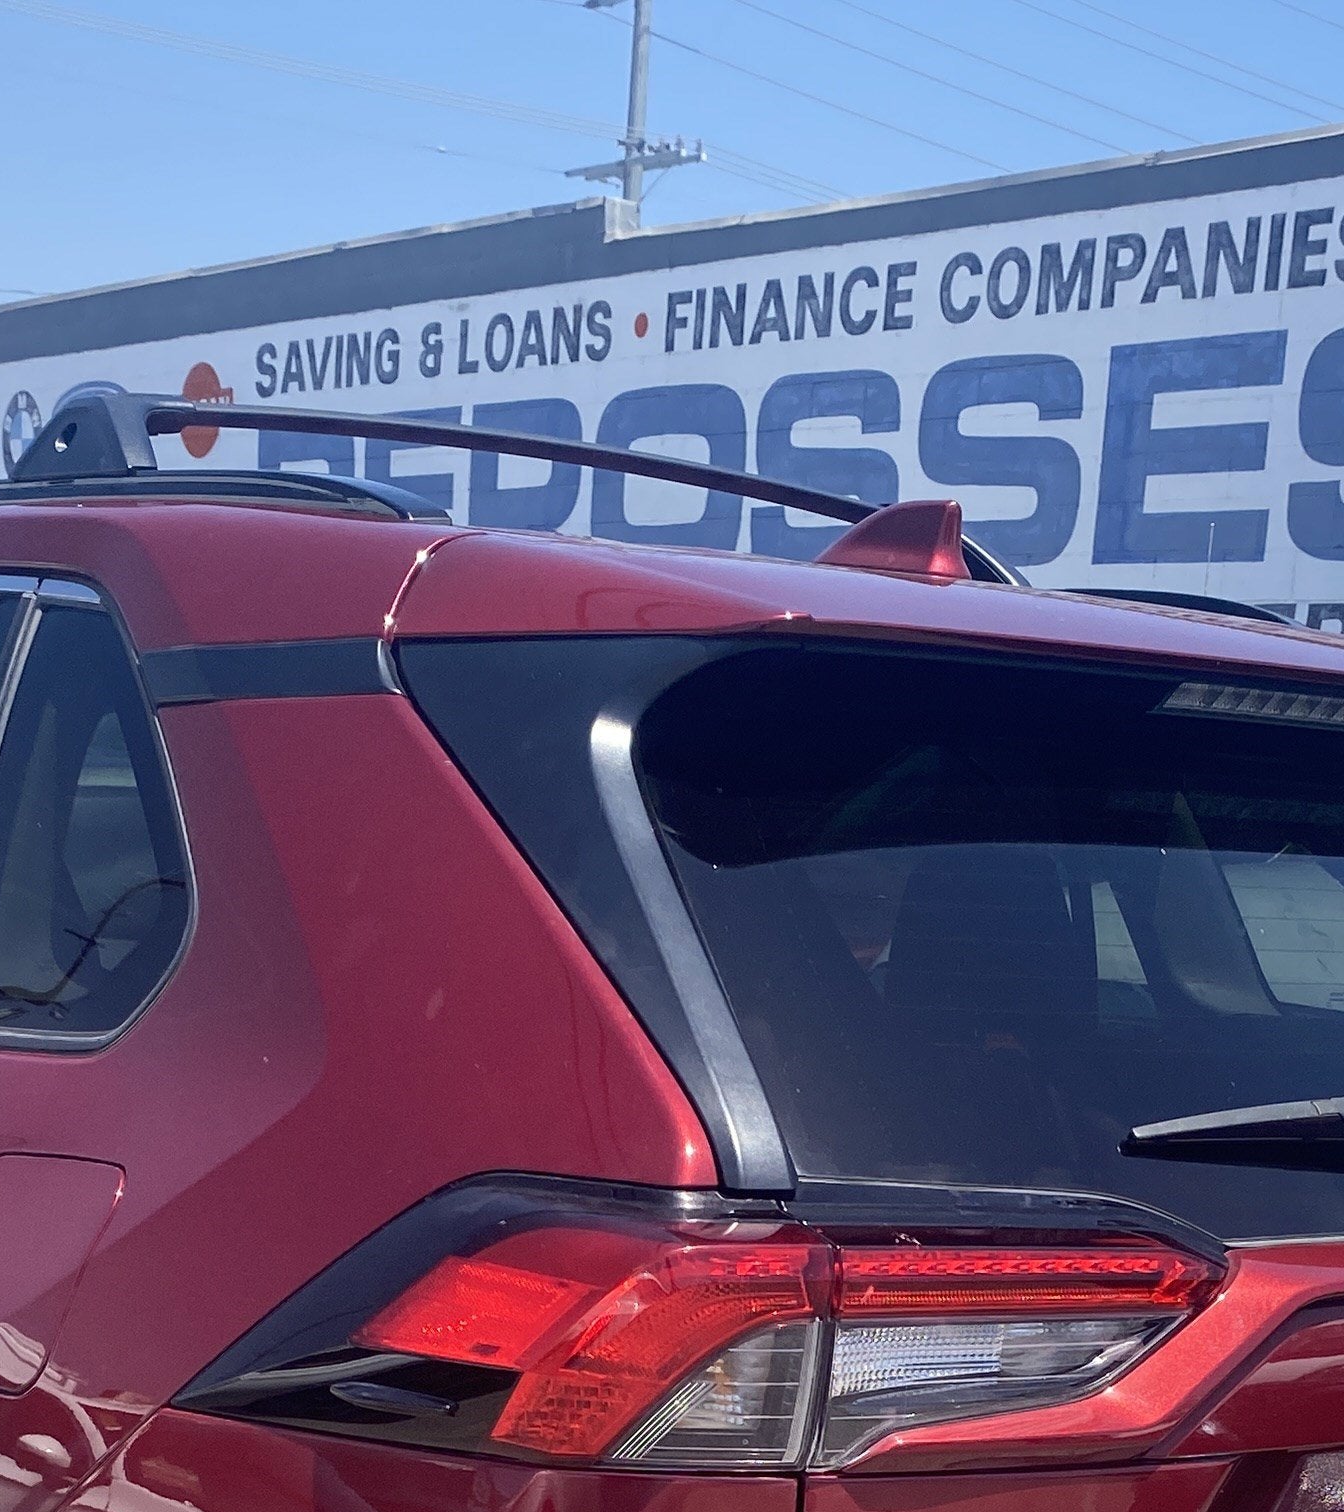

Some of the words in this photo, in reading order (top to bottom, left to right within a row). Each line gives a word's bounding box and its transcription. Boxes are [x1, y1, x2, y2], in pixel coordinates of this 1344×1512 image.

[255, 328, 401, 399] SAVING
[419, 321, 444, 378] &
[458, 299, 613, 374] LOANS
[664, 260, 917, 352] FINANCE
